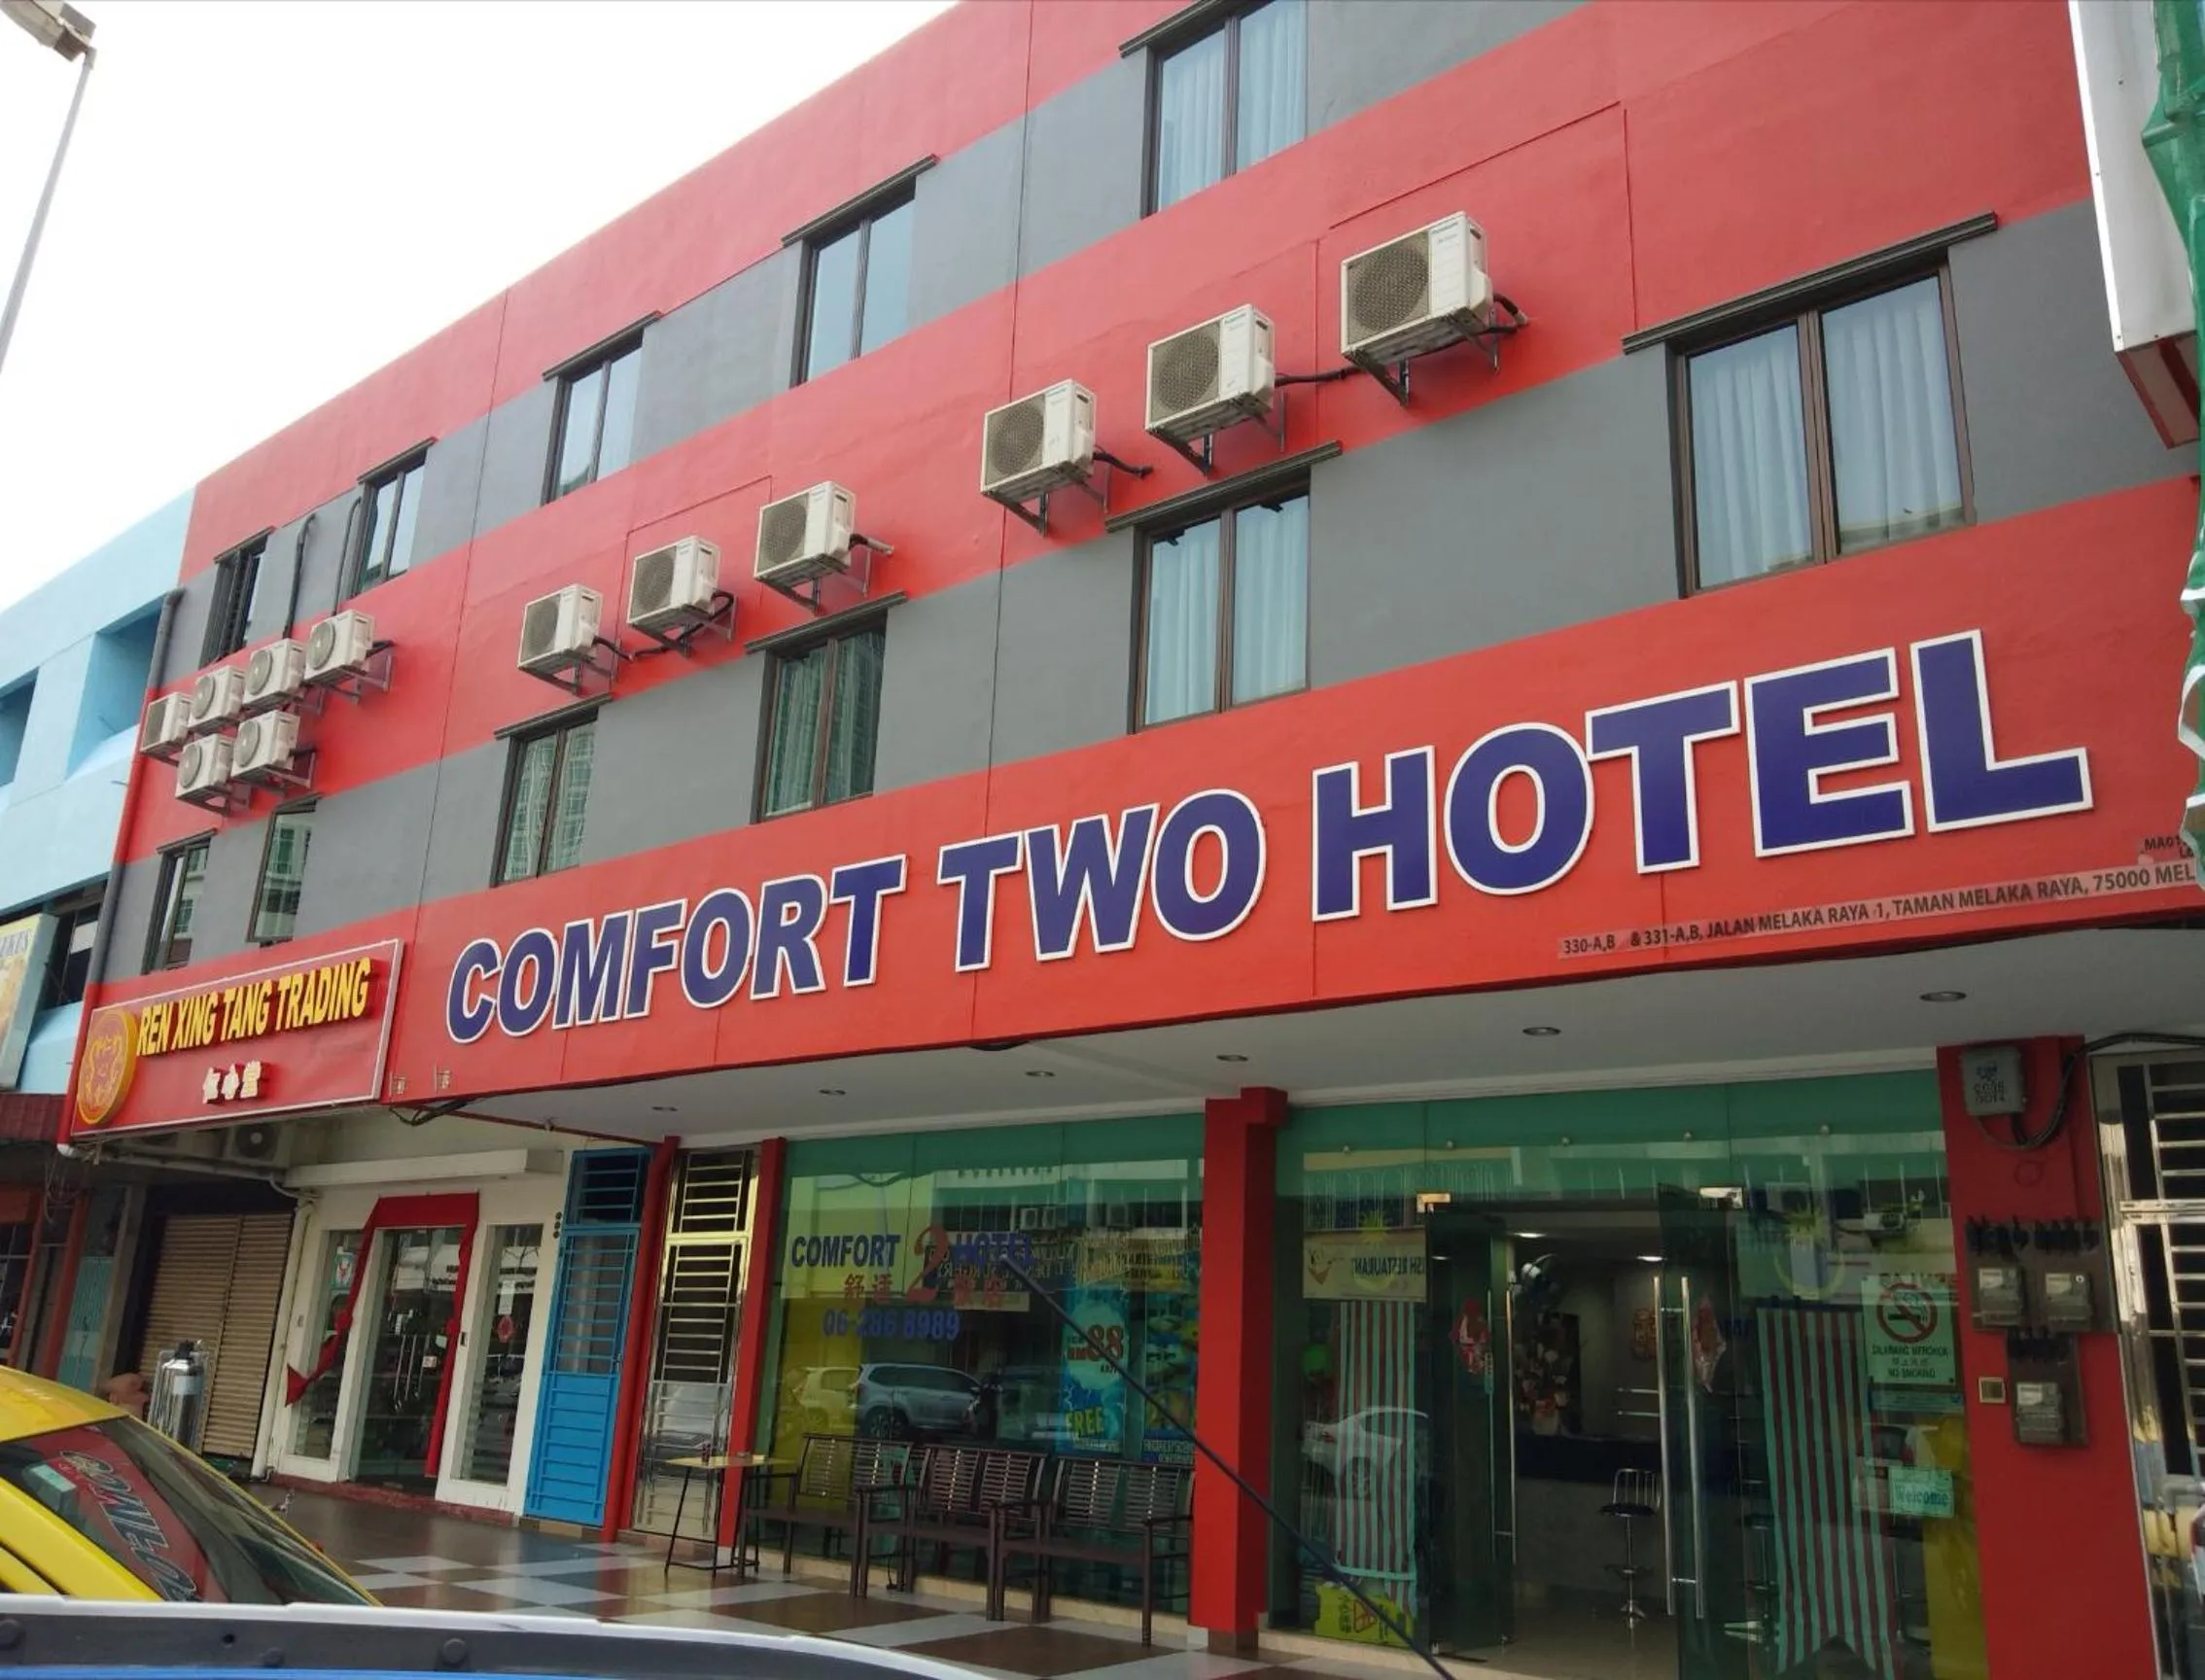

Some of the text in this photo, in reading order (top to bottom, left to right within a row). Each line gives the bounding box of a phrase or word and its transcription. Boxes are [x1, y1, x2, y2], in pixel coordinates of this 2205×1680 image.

[446, 628, 2094, 1044] COMFORT TWO HOTEL
[1562, 933, 1616, 955] 330-A,B
[1630, 932, 1640, 947] &
[1706, 917, 1755, 939] JALAN
[1758, 905, 1824, 931] MELAKA
[1828, 902, 1870, 924] RAYA
[1892, 892, 1955, 916] TAMAN
[1958, 882, 2033, 908] MELAKA
[2037, 876, 2088, 899] RAYA,
[2092, 867, 2152, 892] 75000
[136, 957, 371, 1057] REN XING TANG TRADING
[791, 1234, 901, 1268] COMFORT
[906, 1224, 951, 1305] 2
[1065, 1407, 1104, 1437] FREE
